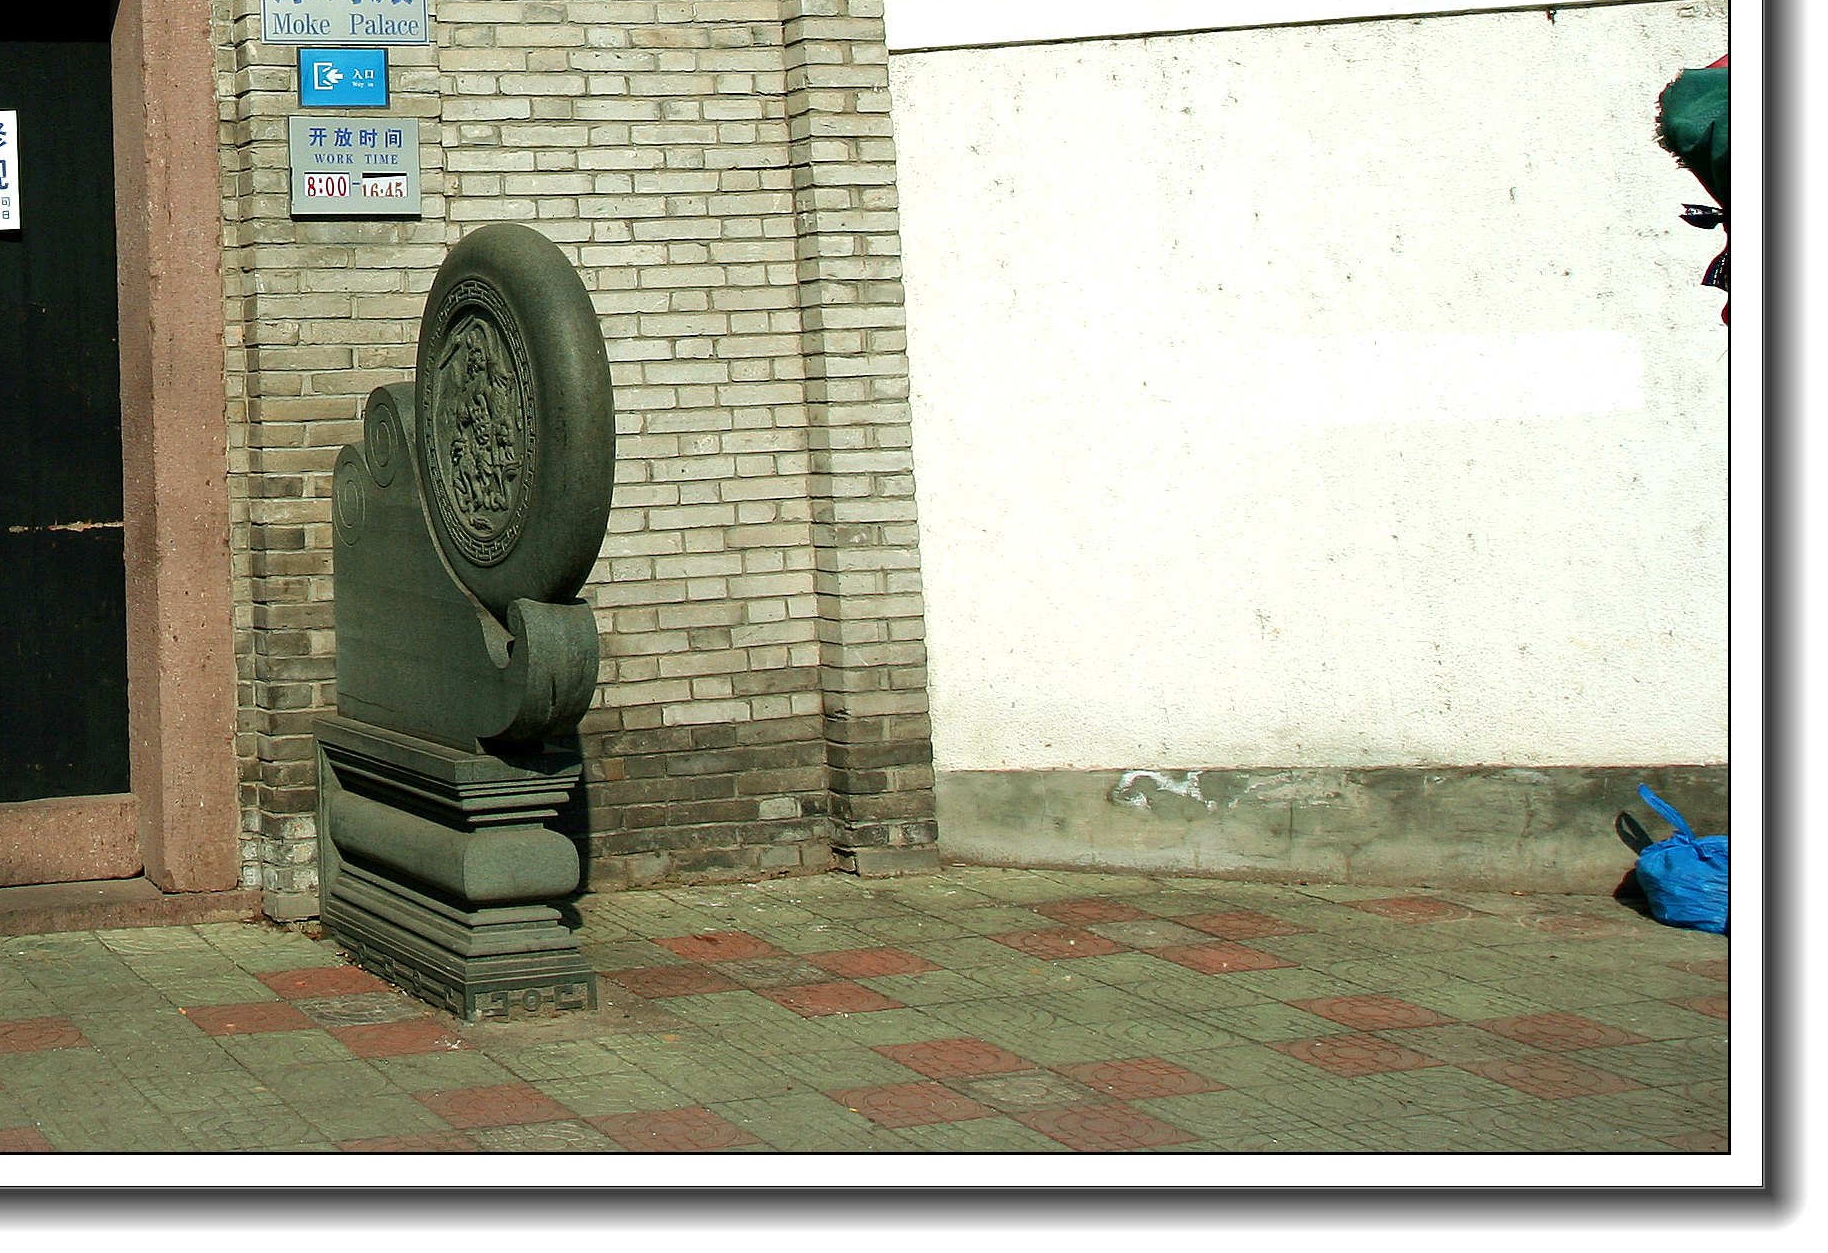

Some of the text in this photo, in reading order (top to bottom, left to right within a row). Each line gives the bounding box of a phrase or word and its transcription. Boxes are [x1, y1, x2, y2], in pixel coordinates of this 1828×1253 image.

[272, 12, 420, 36] Moke Palace
[352, 68, 374, 80] 入口
[309, 127, 403, 148] 开放时间
[315, 153, 399, 165] WORK TIME
